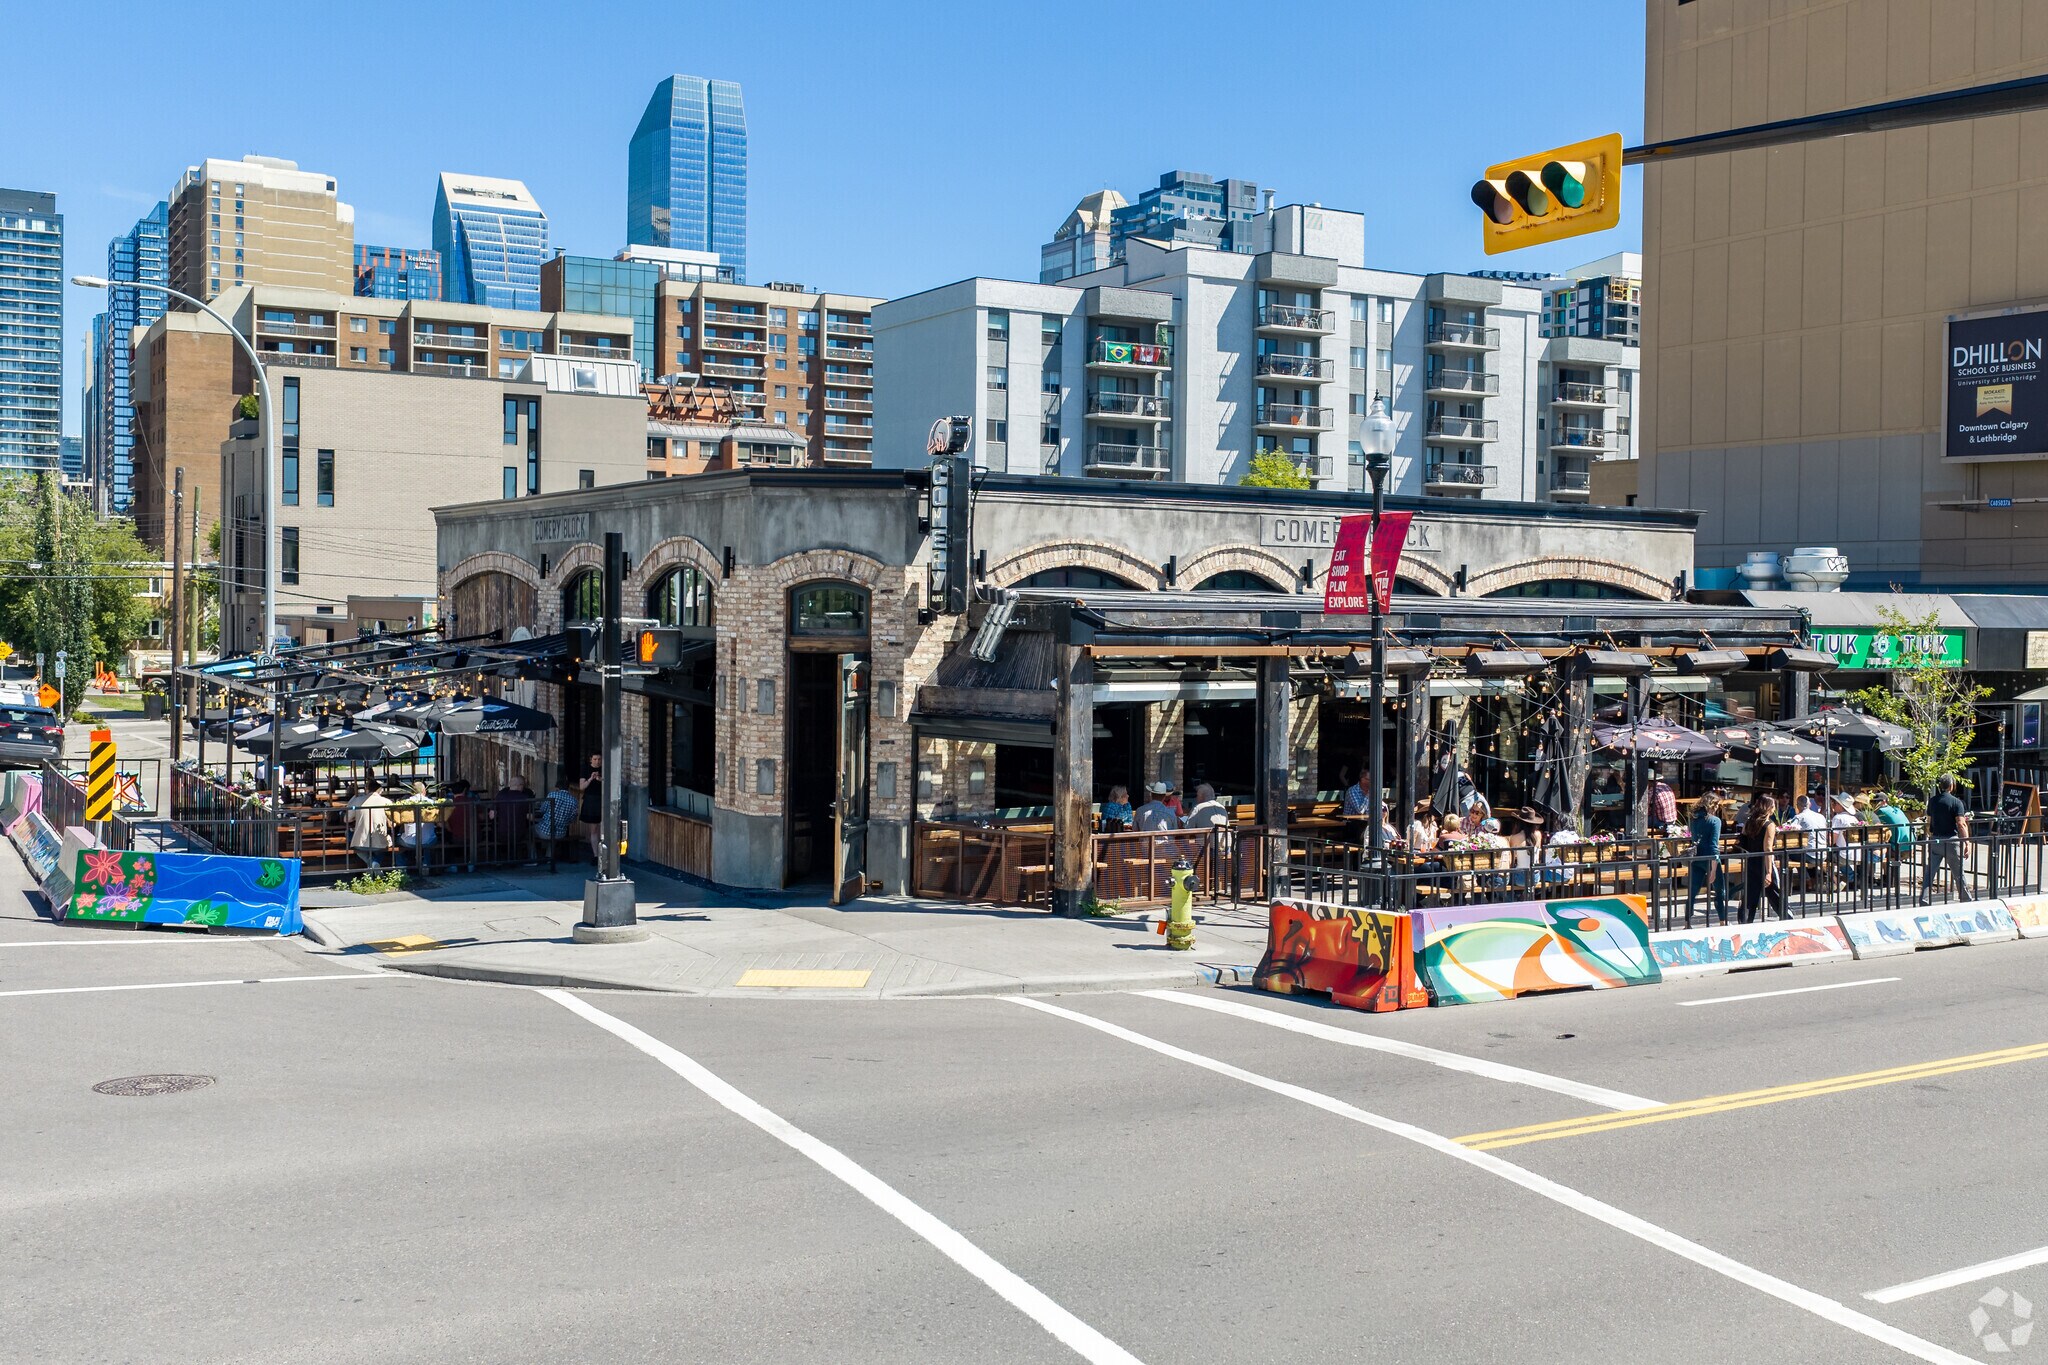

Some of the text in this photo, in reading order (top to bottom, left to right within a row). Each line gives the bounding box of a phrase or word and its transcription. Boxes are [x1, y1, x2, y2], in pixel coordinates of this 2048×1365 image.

[1953, 338, 2042, 367] DHILLON
[1958, 367, 1987, 376] SCHOOL
[2002, 362, 2036, 372] BUSINESS
[1958, 378, 1990, 386] University
[2002, 374, 2037, 383] Lethbridge
[1959, 421, 2029, 432] Downtown Calgary
[1969, 434, 2017, 443] & Lethbridge
[535, 516, 585, 540] COMERY BLOCK
[932, 464, 948, 591] COMERY
[1275, 519, 1341, 544] COMER
[1334, 550, 1346, 561] EAT
[1331, 564, 1349, 577] SHOP
[1329, 580, 1347, 592] PLAY
[1328, 596, 1364, 608] EXPLORE
[1811, 634, 1949, 654] TUK TUK
